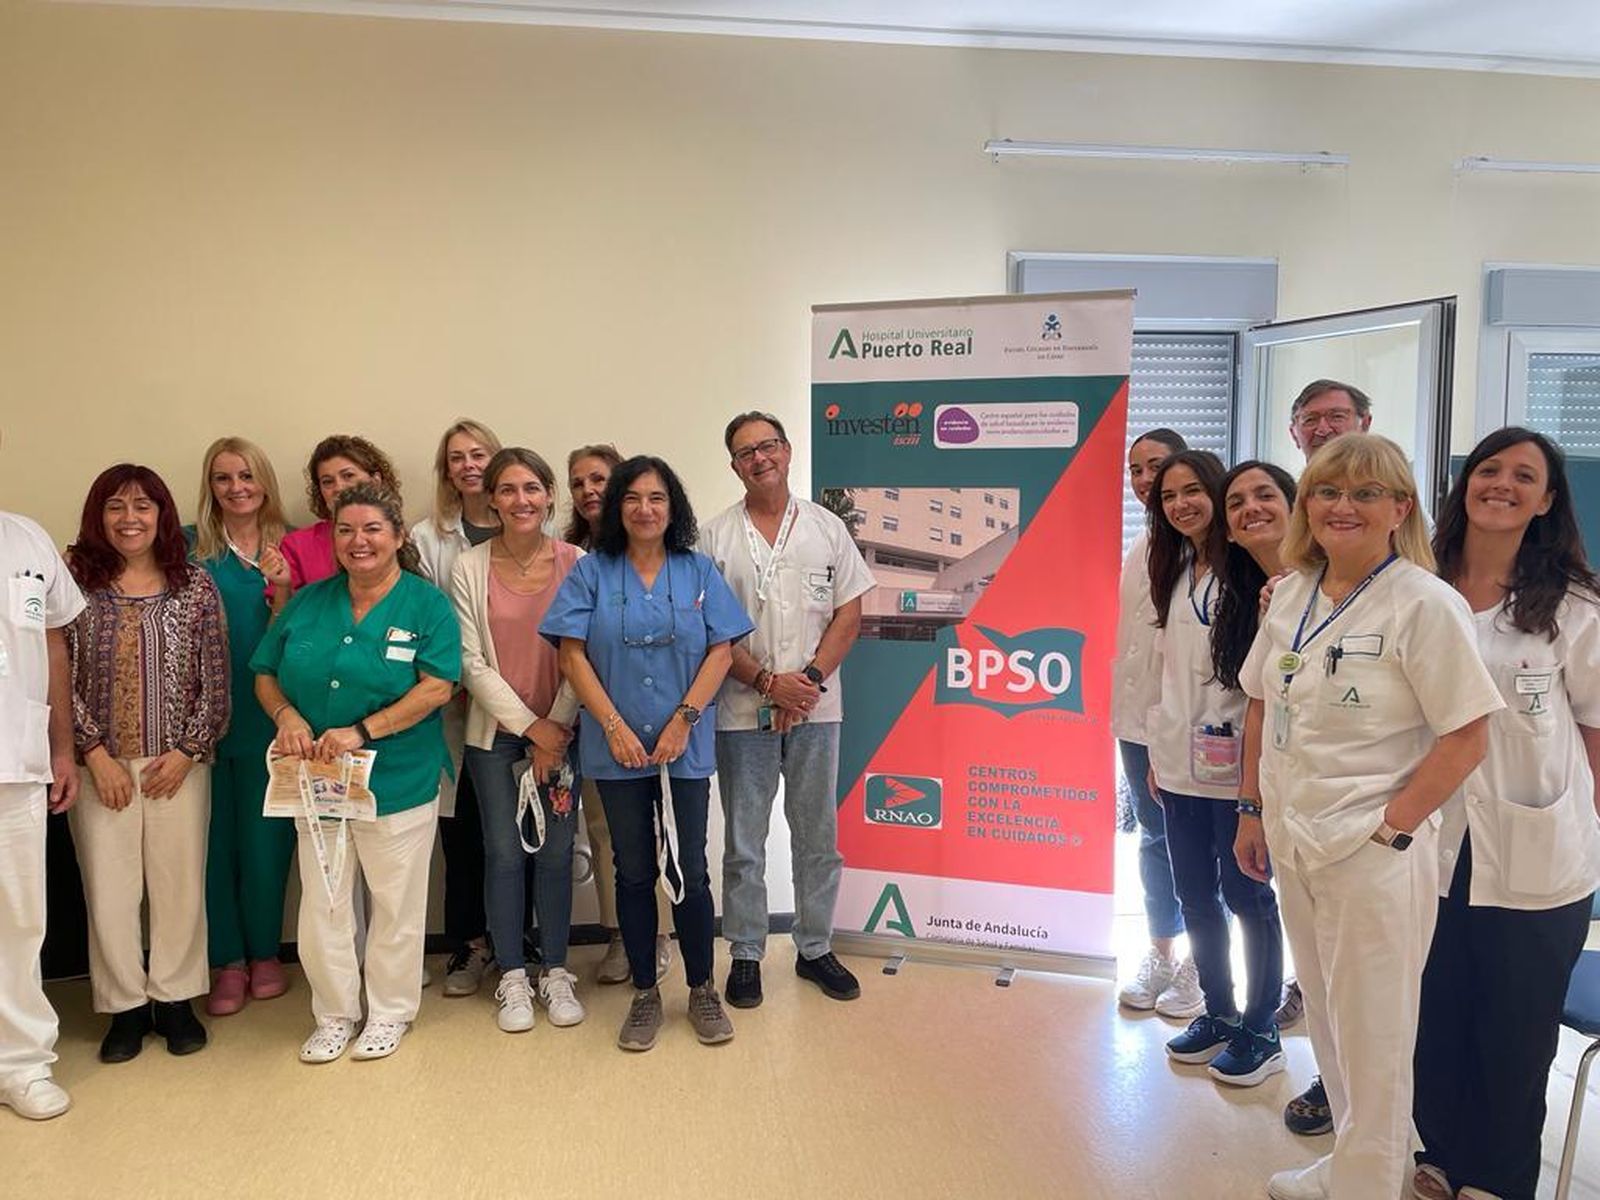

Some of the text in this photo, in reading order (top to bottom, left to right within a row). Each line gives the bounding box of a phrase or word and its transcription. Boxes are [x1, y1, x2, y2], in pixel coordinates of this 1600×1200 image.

[862, 328, 973, 343] Hospital Universitario
[862, 337, 972, 359] Puerto Real
[946, 647, 1072, 695] BPSO
[968, 765, 1037, 781] CENTROS
[968, 780, 1098, 801] COMPROMETIDOS
[967, 796, 1021, 810] CON LA
[873, 808, 934, 826] RNAO
[967, 811, 1059, 828] EXCELENCIA
[967, 826, 1066, 846] EN CUIDADOS
[926, 915, 1048, 939] Junta de Andalucía
